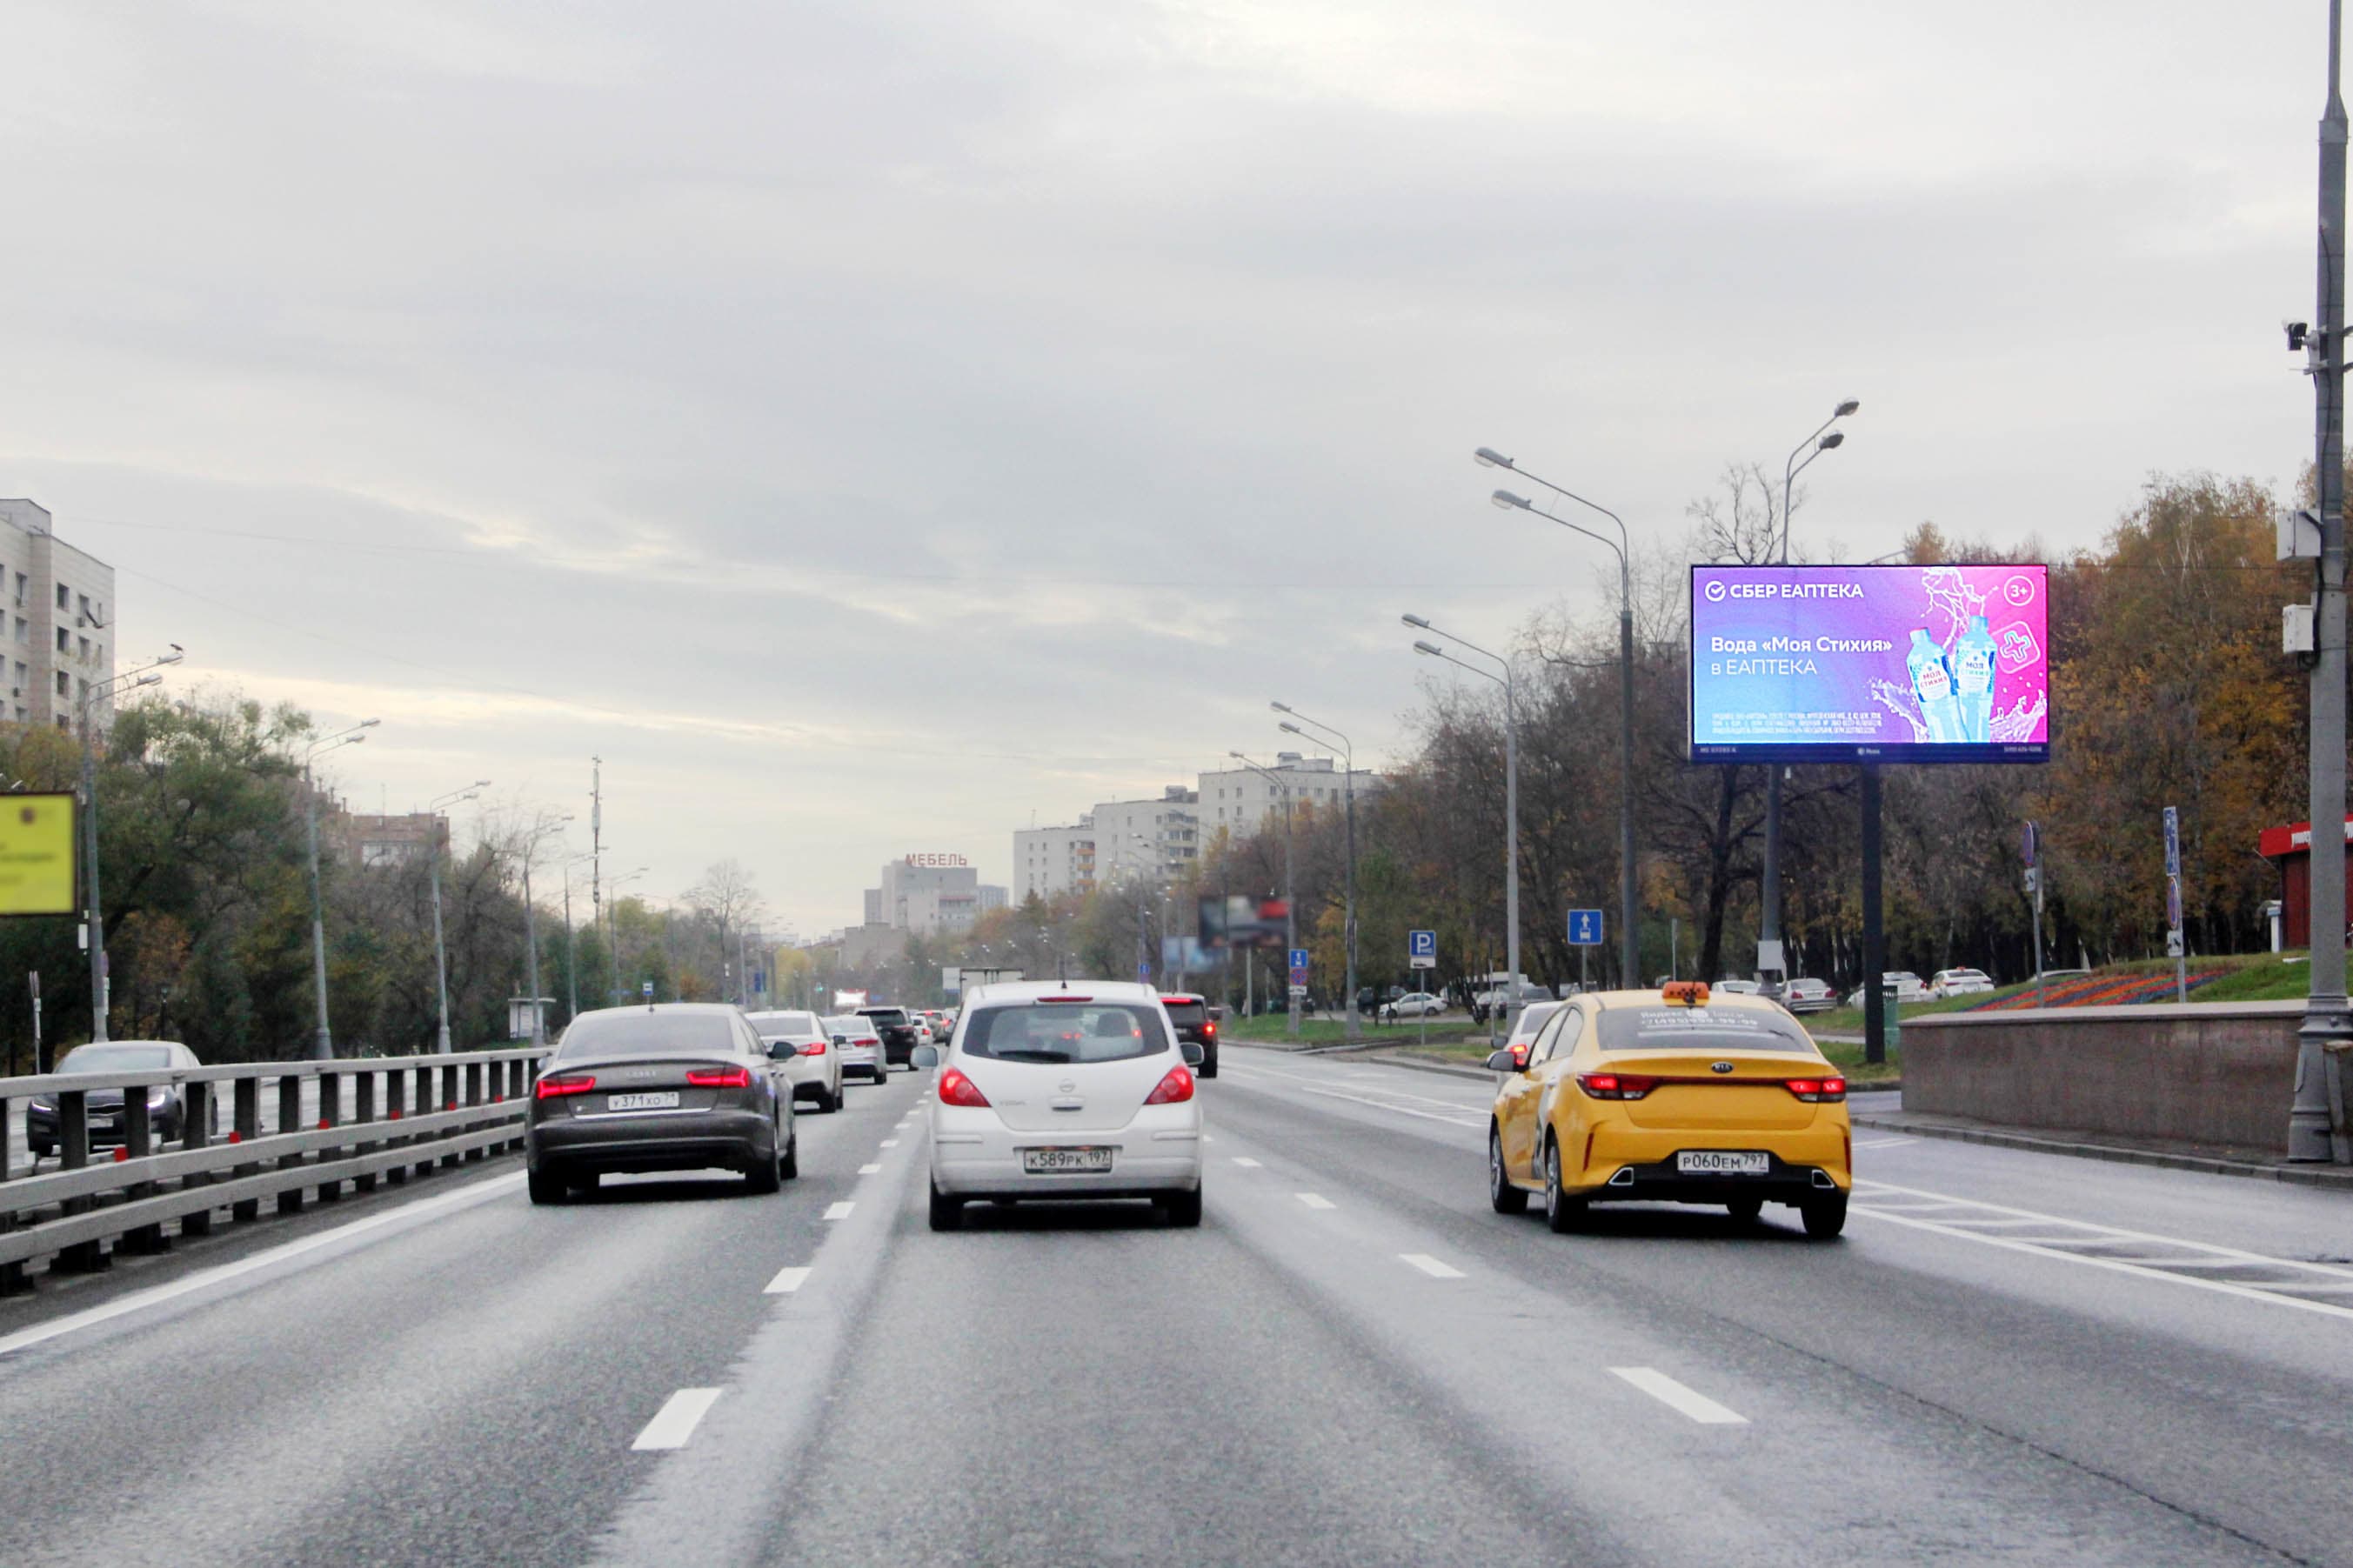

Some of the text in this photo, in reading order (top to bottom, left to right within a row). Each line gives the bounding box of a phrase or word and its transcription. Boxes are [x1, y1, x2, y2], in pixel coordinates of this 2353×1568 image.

[1729, 584, 1864, 598] СБЕР ЕАПТЕКА
[2010, 584, 2028, 597] 3+
[1711, 636, 1893, 654] Вода «Моя Стихия»
[1711, 659, 1817, 675] в ЕАПТЕКА
[906, 853, 967, 866] МЕБЕЛЬ
